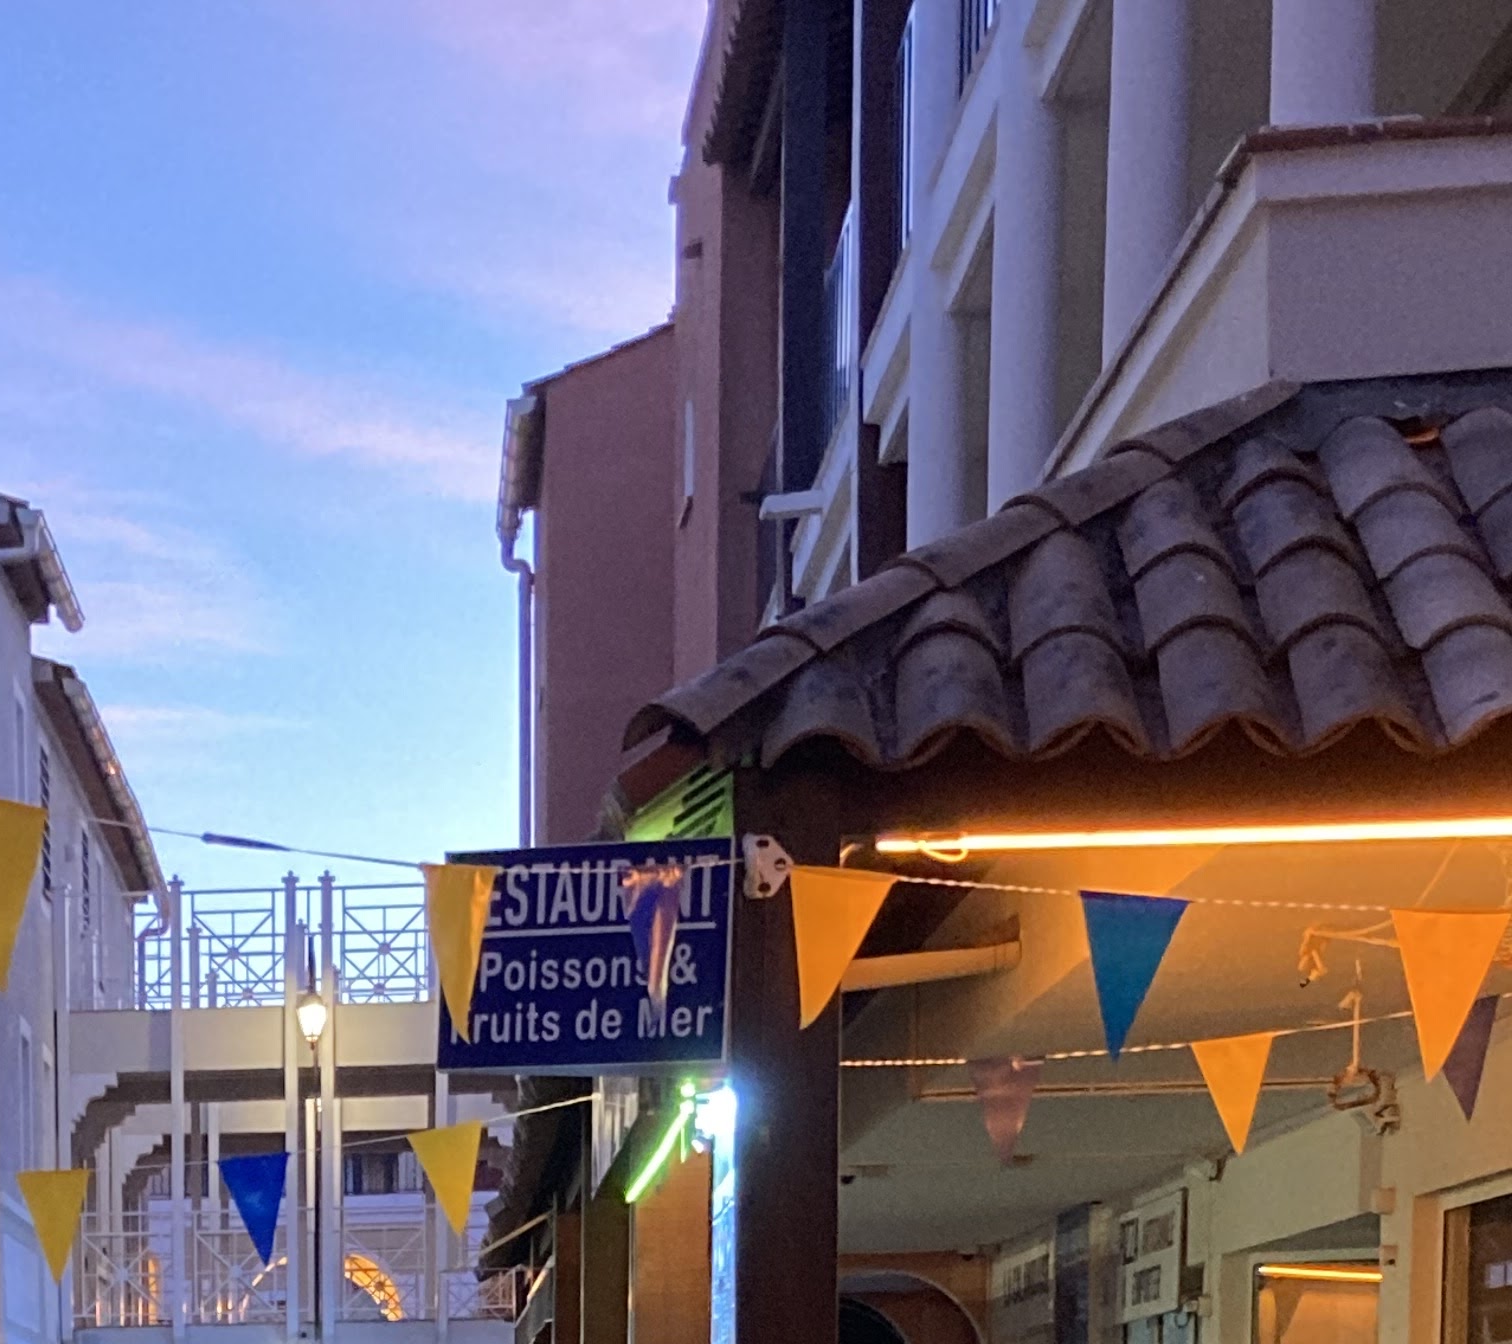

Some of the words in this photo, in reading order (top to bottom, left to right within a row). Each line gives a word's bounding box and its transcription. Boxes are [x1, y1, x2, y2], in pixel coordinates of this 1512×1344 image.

[670, 943, 698, 985] &
[450, 1002, 561, 1045] ruits
[574, 998, 623, 1041] de
[637, 998, 713, 1039] Mer
